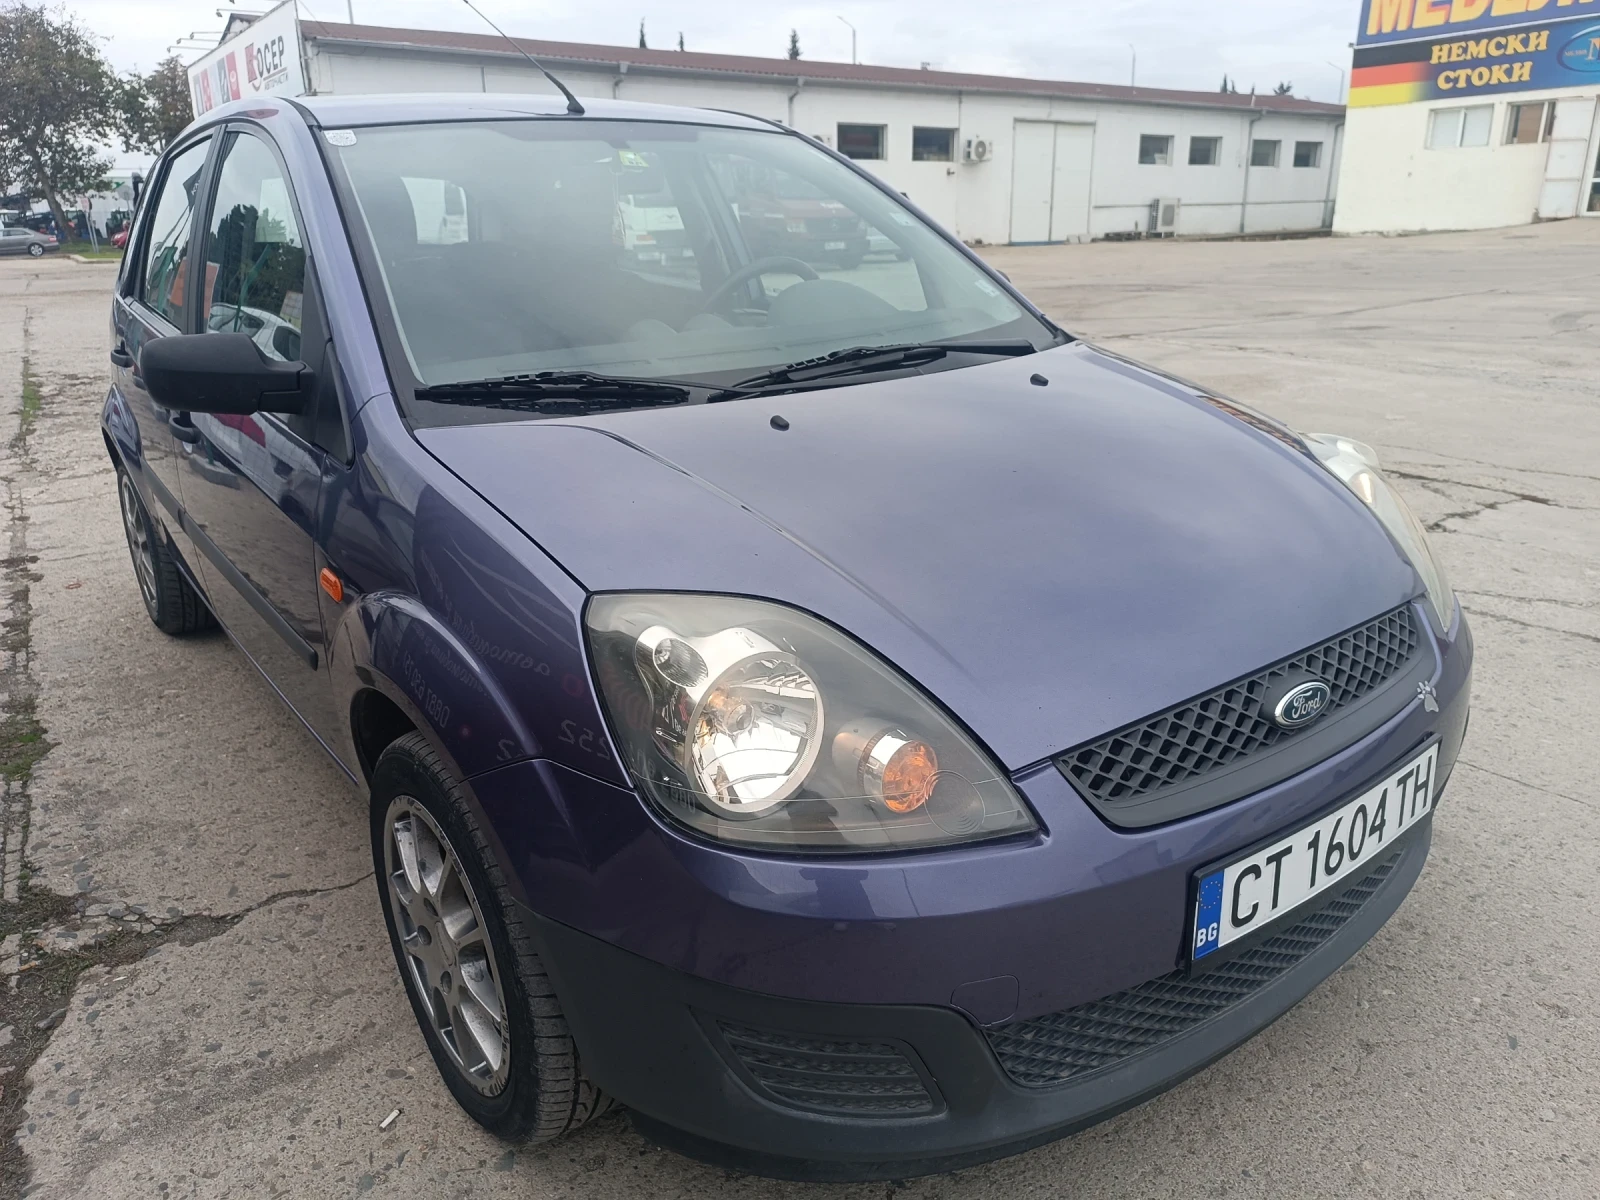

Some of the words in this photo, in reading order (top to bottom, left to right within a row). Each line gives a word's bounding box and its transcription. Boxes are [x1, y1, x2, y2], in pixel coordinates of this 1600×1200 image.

[1430, 30, 1550, 65] НЕМСКИ
[1437, 61, 1533, 90] СТОКИ
[1291, 690, 1322, 719] Ford
[1230, 845, 1293, 929] CT
[1307, 787, 1389, 889] 1604
[1396, 754, 1433, 829] TH
[1196, 921, 1218, 947] BG
